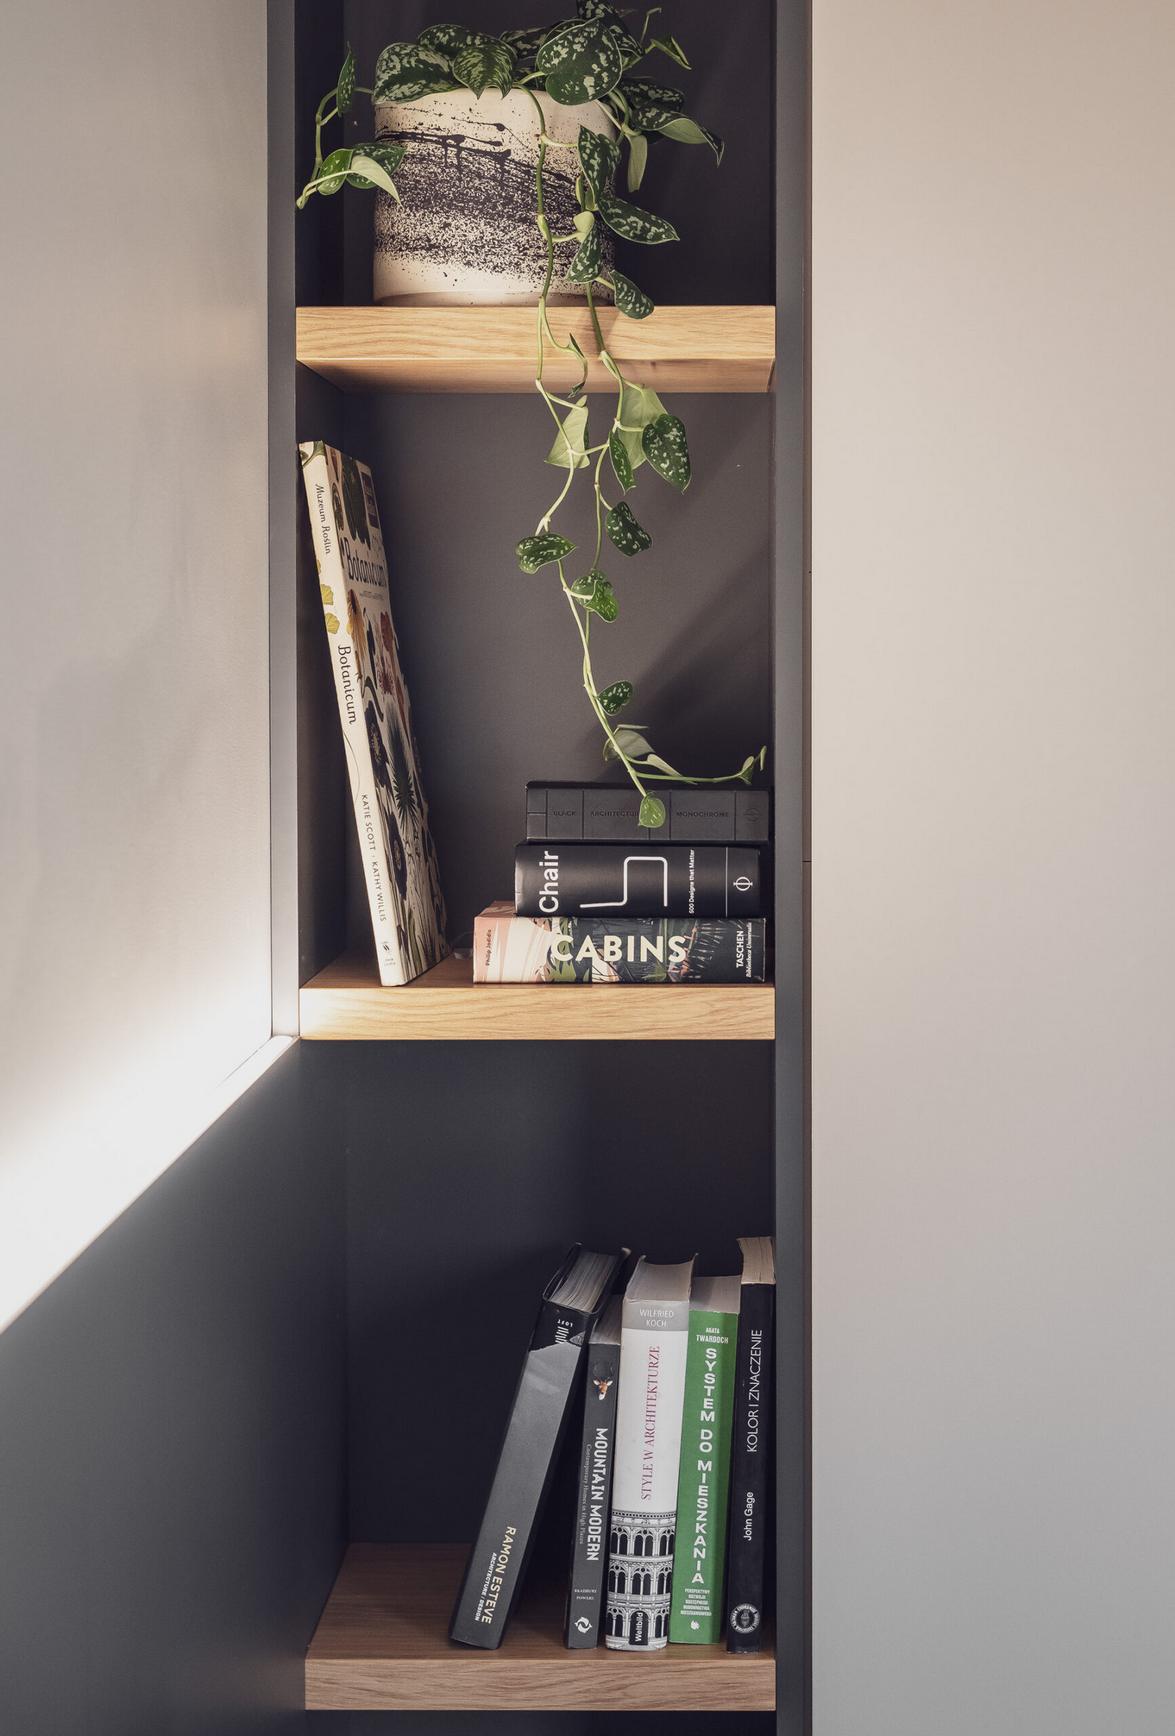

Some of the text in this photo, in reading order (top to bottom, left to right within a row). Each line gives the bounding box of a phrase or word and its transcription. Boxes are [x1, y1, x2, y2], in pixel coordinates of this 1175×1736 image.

[316, 484, 326, 522] Muzeum
[338, 645, 357, 724] Botanicum
[362, 794, 387, 922] KATIE SCOTT KATHY WILLIS
[538, 851, 559, 914] Chair
[551, 935, 687, 962] CABINS
[639, 1309, 674, 1318] WILFRIED
[646, 1320, 667, 1328] KOCH
[696, 1334, 728, 1344] TWARDOCH
[700, 1348, 717, 1422] SYSTEM
[748, 1330, 762, 1401] ZNACZENIE
[641, 1346, 660, 1500] STYLE W ARCHITEKTURZE
[699, 1429, 713, 1453] DO
[747, 1409, 759, 1452] KOLOR
[586, 1428, 608, 1560] MOUNTAIN MODERN
[744, 1492, 756, 1541] John Gage
[692, 1460, 712, 1584] MIESZKANIA
[481, 1526, 516, 1624] RAMON ESTEVE
[482, 1552, 498, 1598] ARCHITECTURE
[474, 1600, 484, 1621] DESIGN
[634, 1612, 643, 1642] Weltbild
